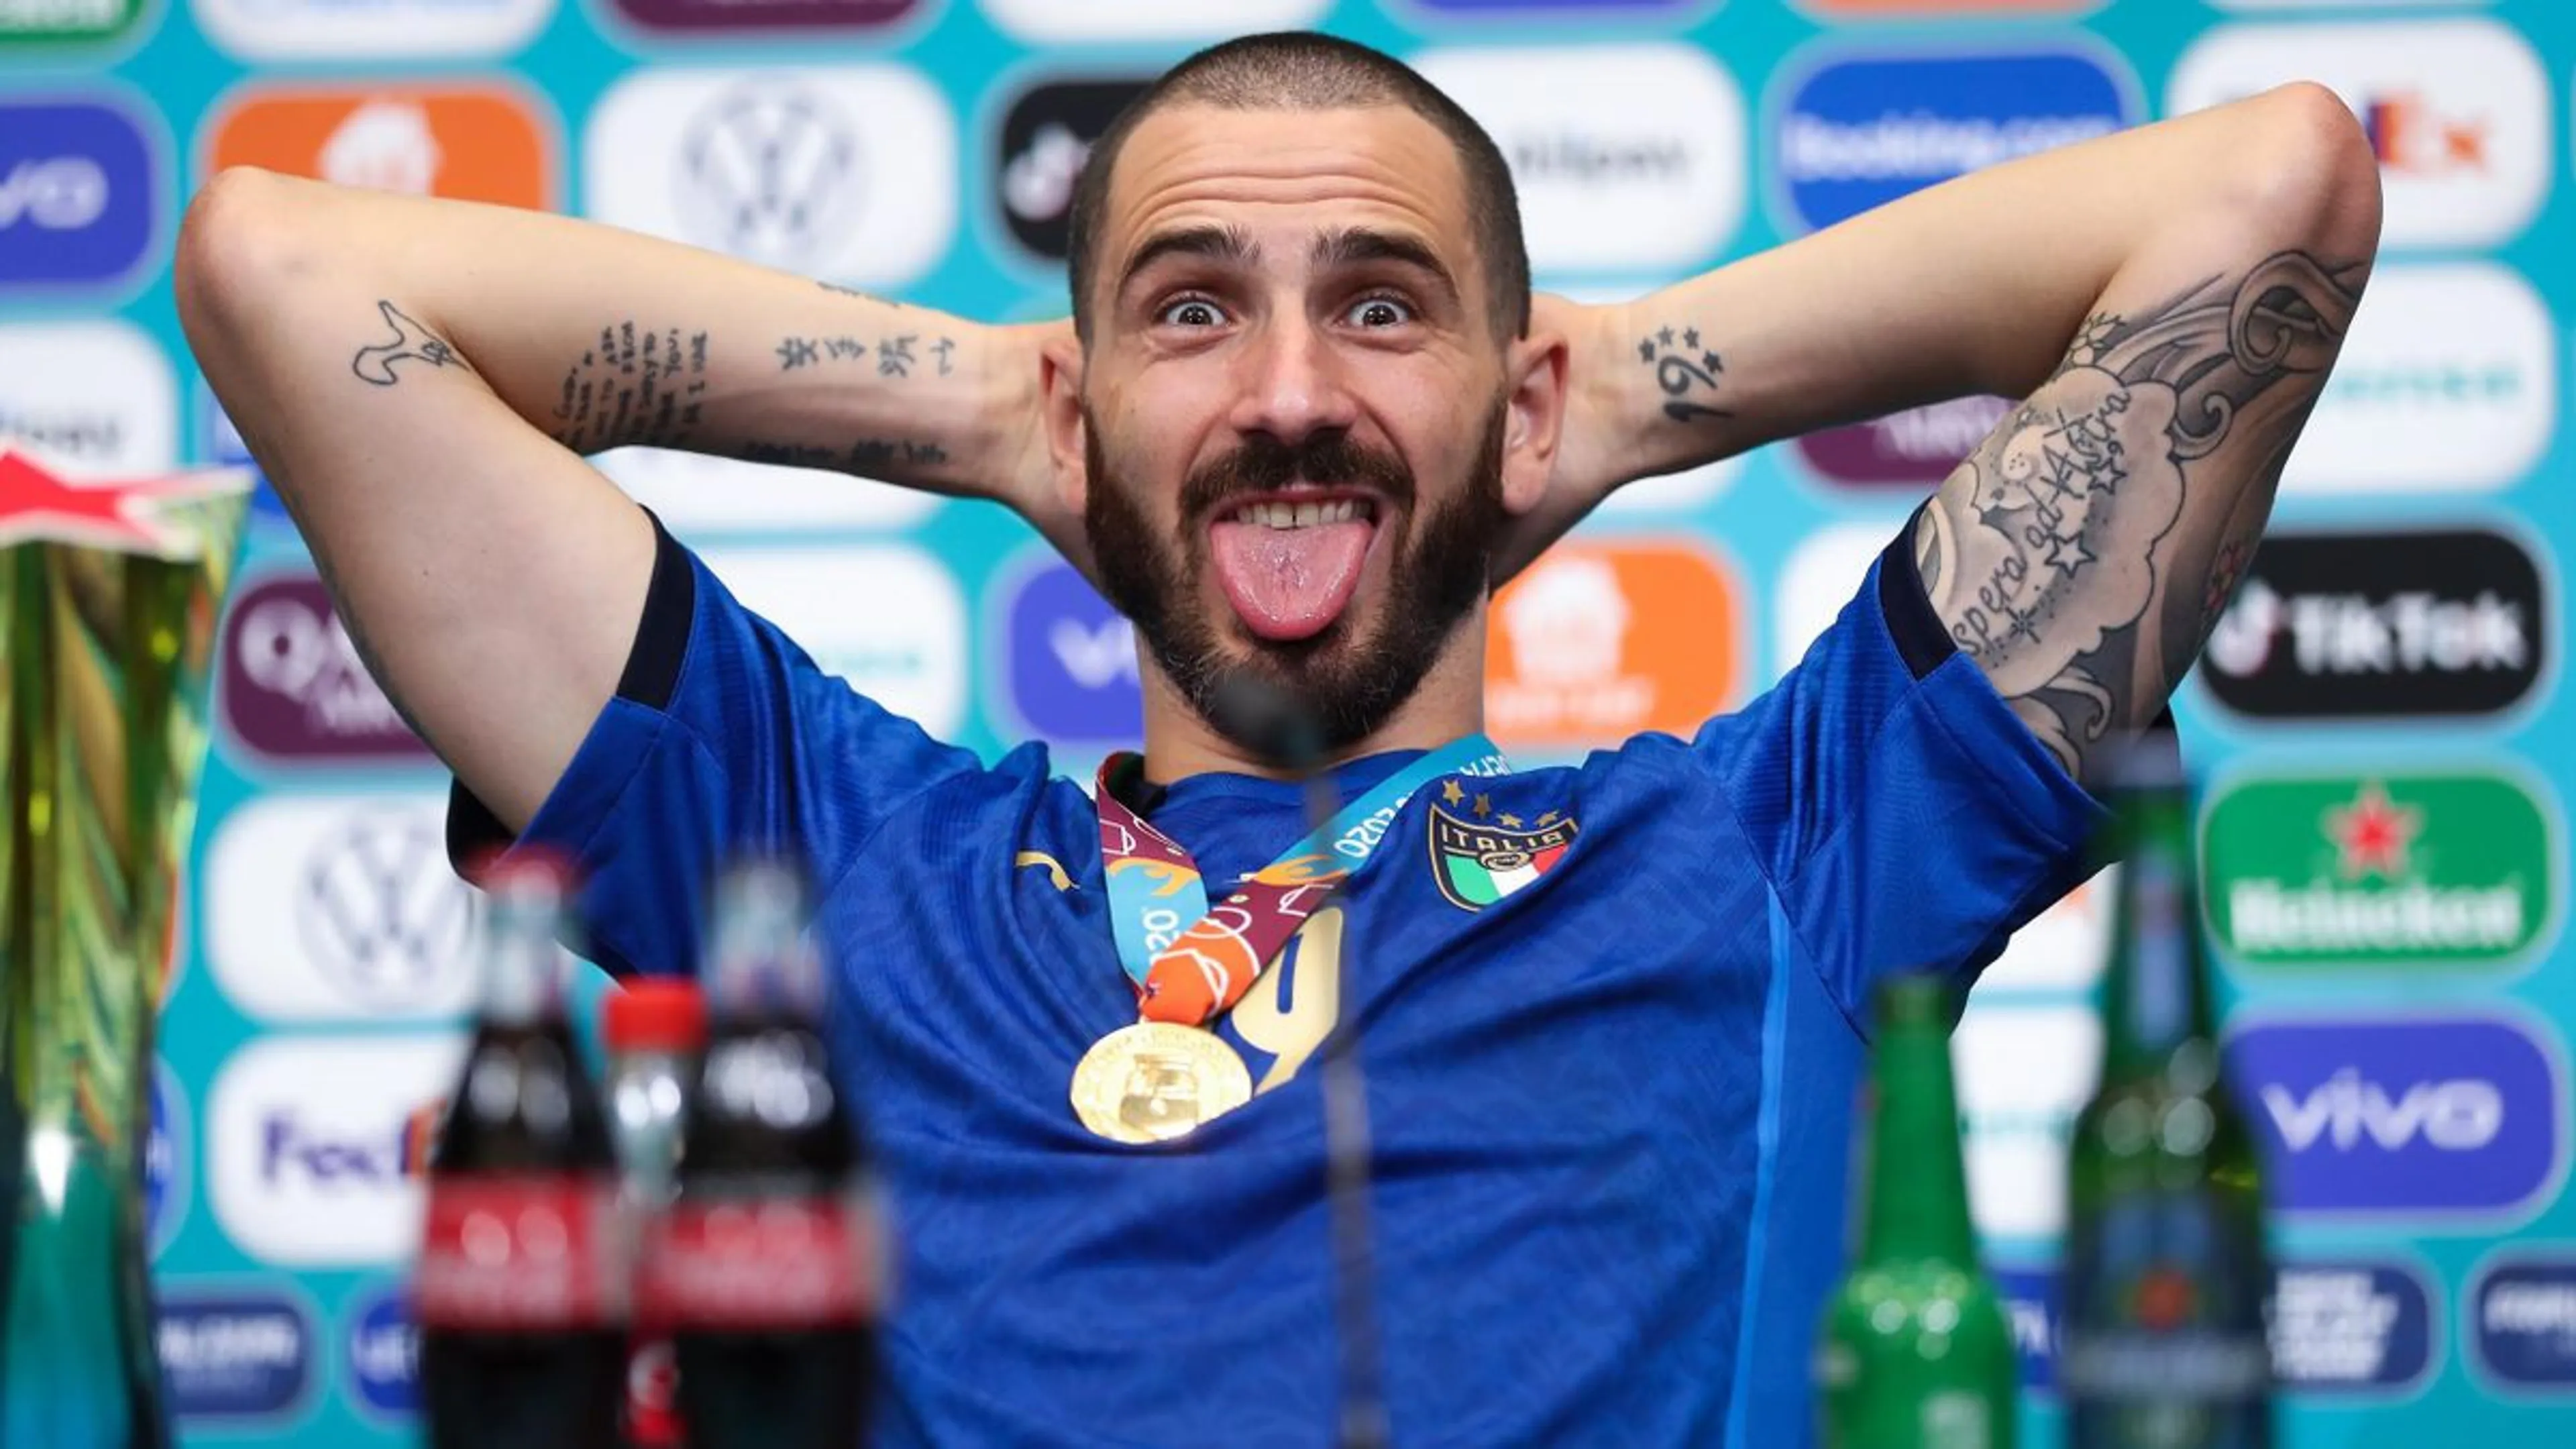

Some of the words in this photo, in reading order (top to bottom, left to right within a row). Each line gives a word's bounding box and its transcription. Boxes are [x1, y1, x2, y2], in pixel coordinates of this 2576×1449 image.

[1784, 109, 2120, 182] Bookingco
[2289, 592, 2528, 676] TikTok
[1442, 822, 1563, 852] ITALIA
[2229, 877, 2525, 949] Heineken
[2258, 1065, 2505, 1152] vivo
